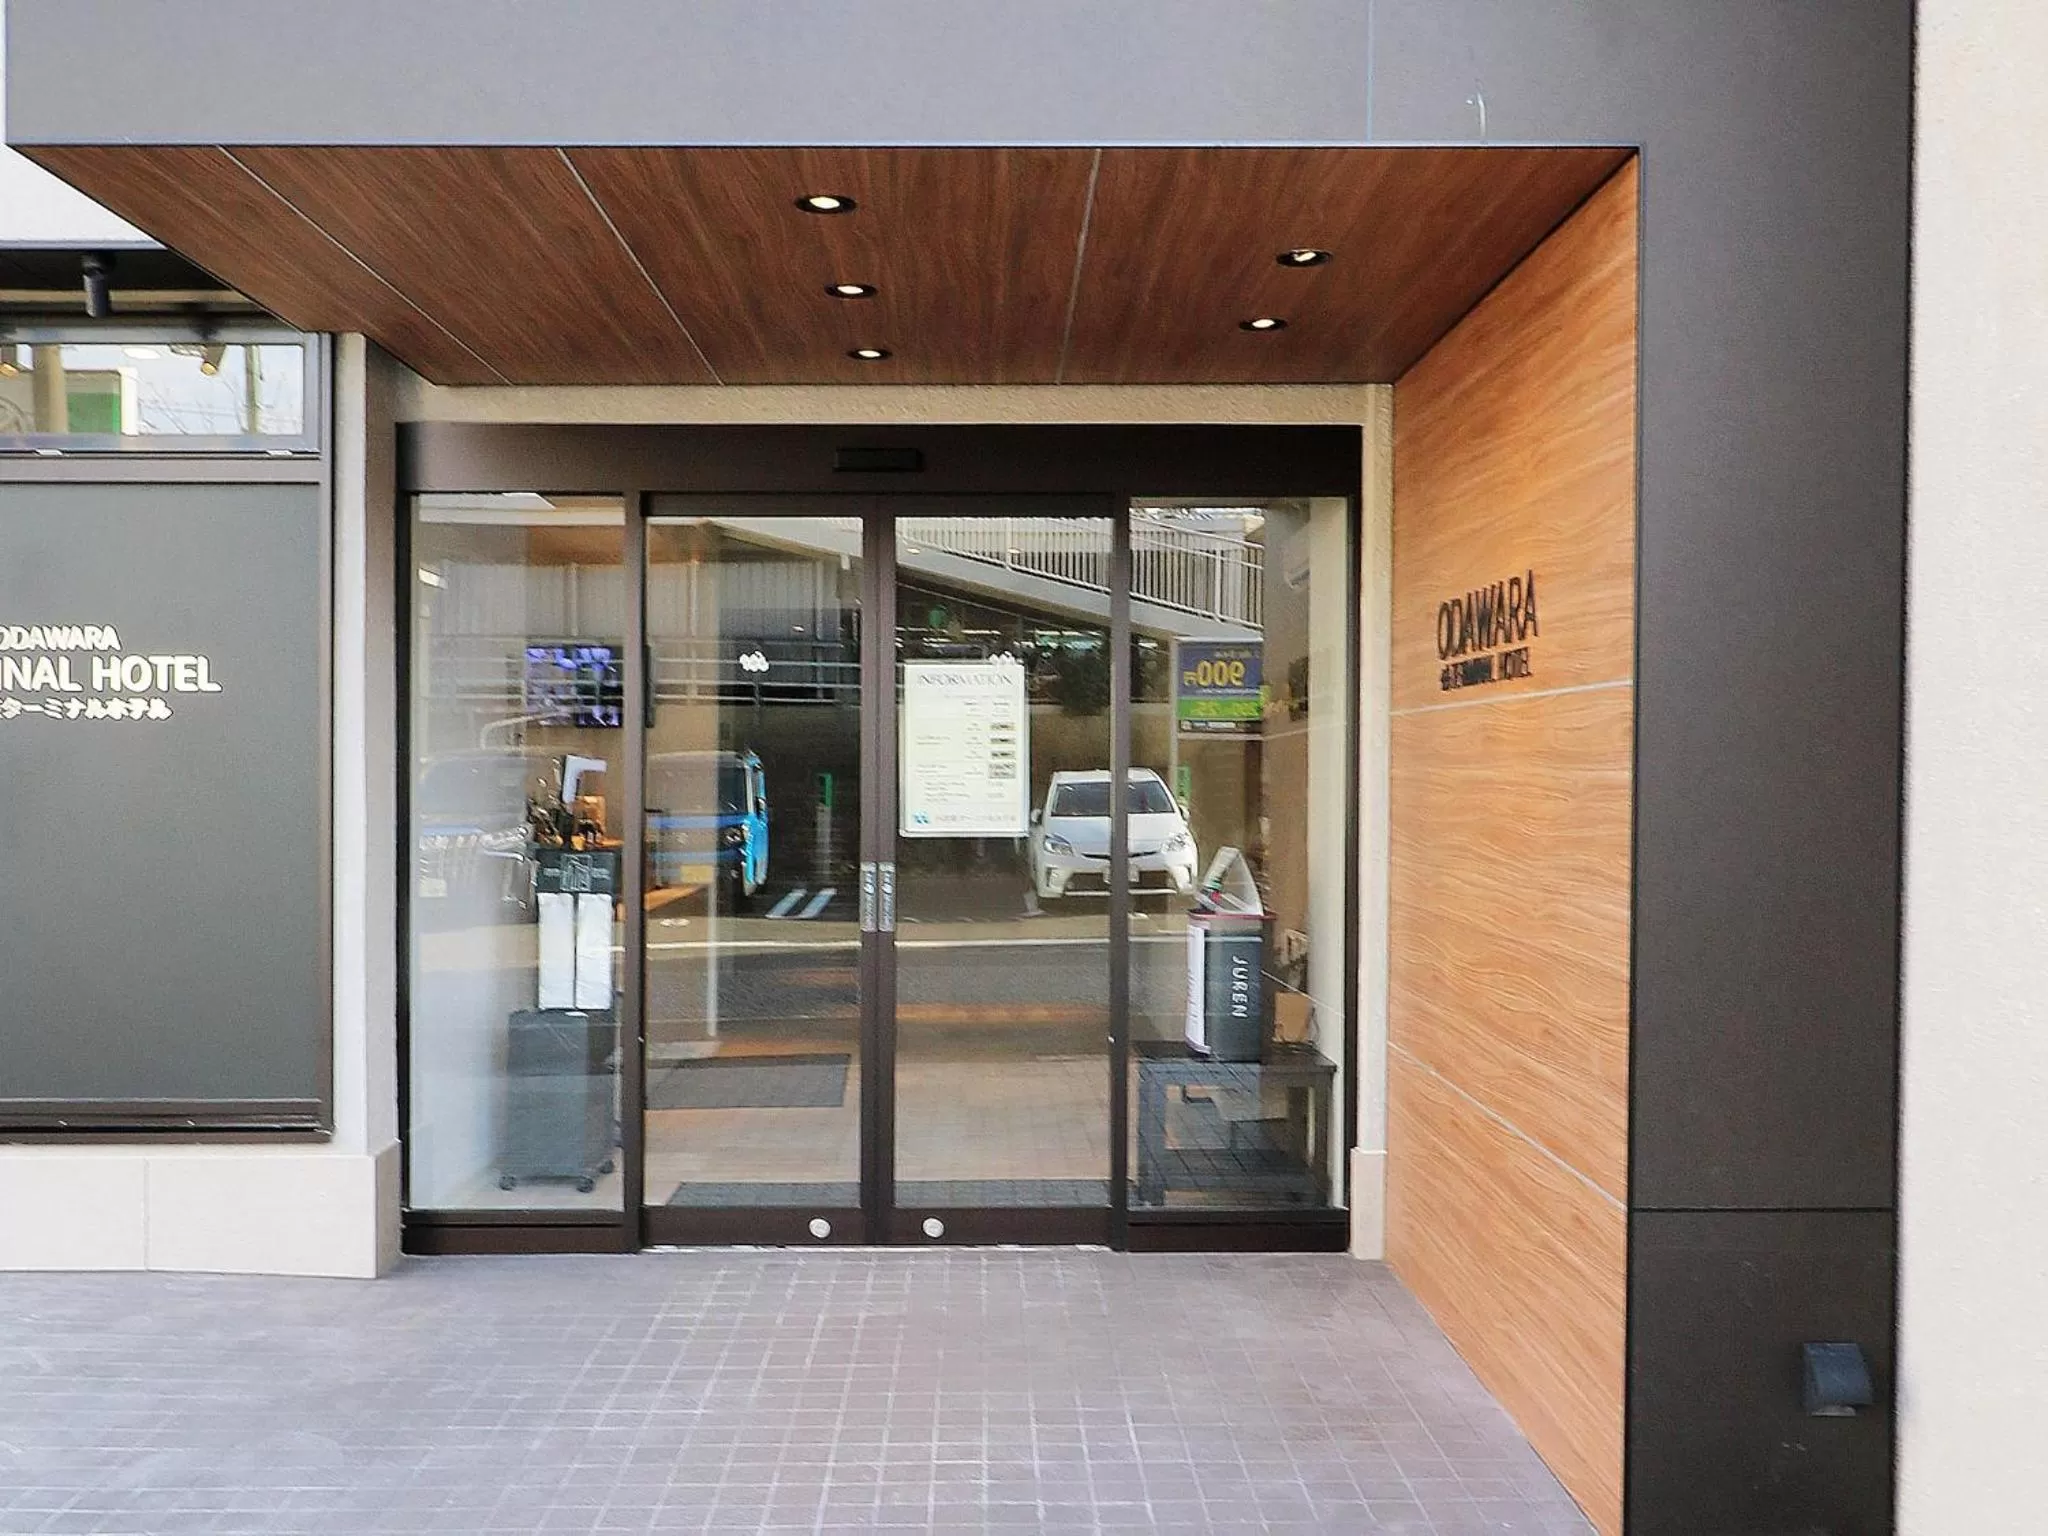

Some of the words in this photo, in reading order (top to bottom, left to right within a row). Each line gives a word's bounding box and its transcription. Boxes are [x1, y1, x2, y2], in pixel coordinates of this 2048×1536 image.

[1438, 569, 1538, 661] ODAWARA
[0, 655, 83, 692] NAL
[92, 655, 223, 692] HOTEL
[0, 696, 174, 721] ターミナルホテル
